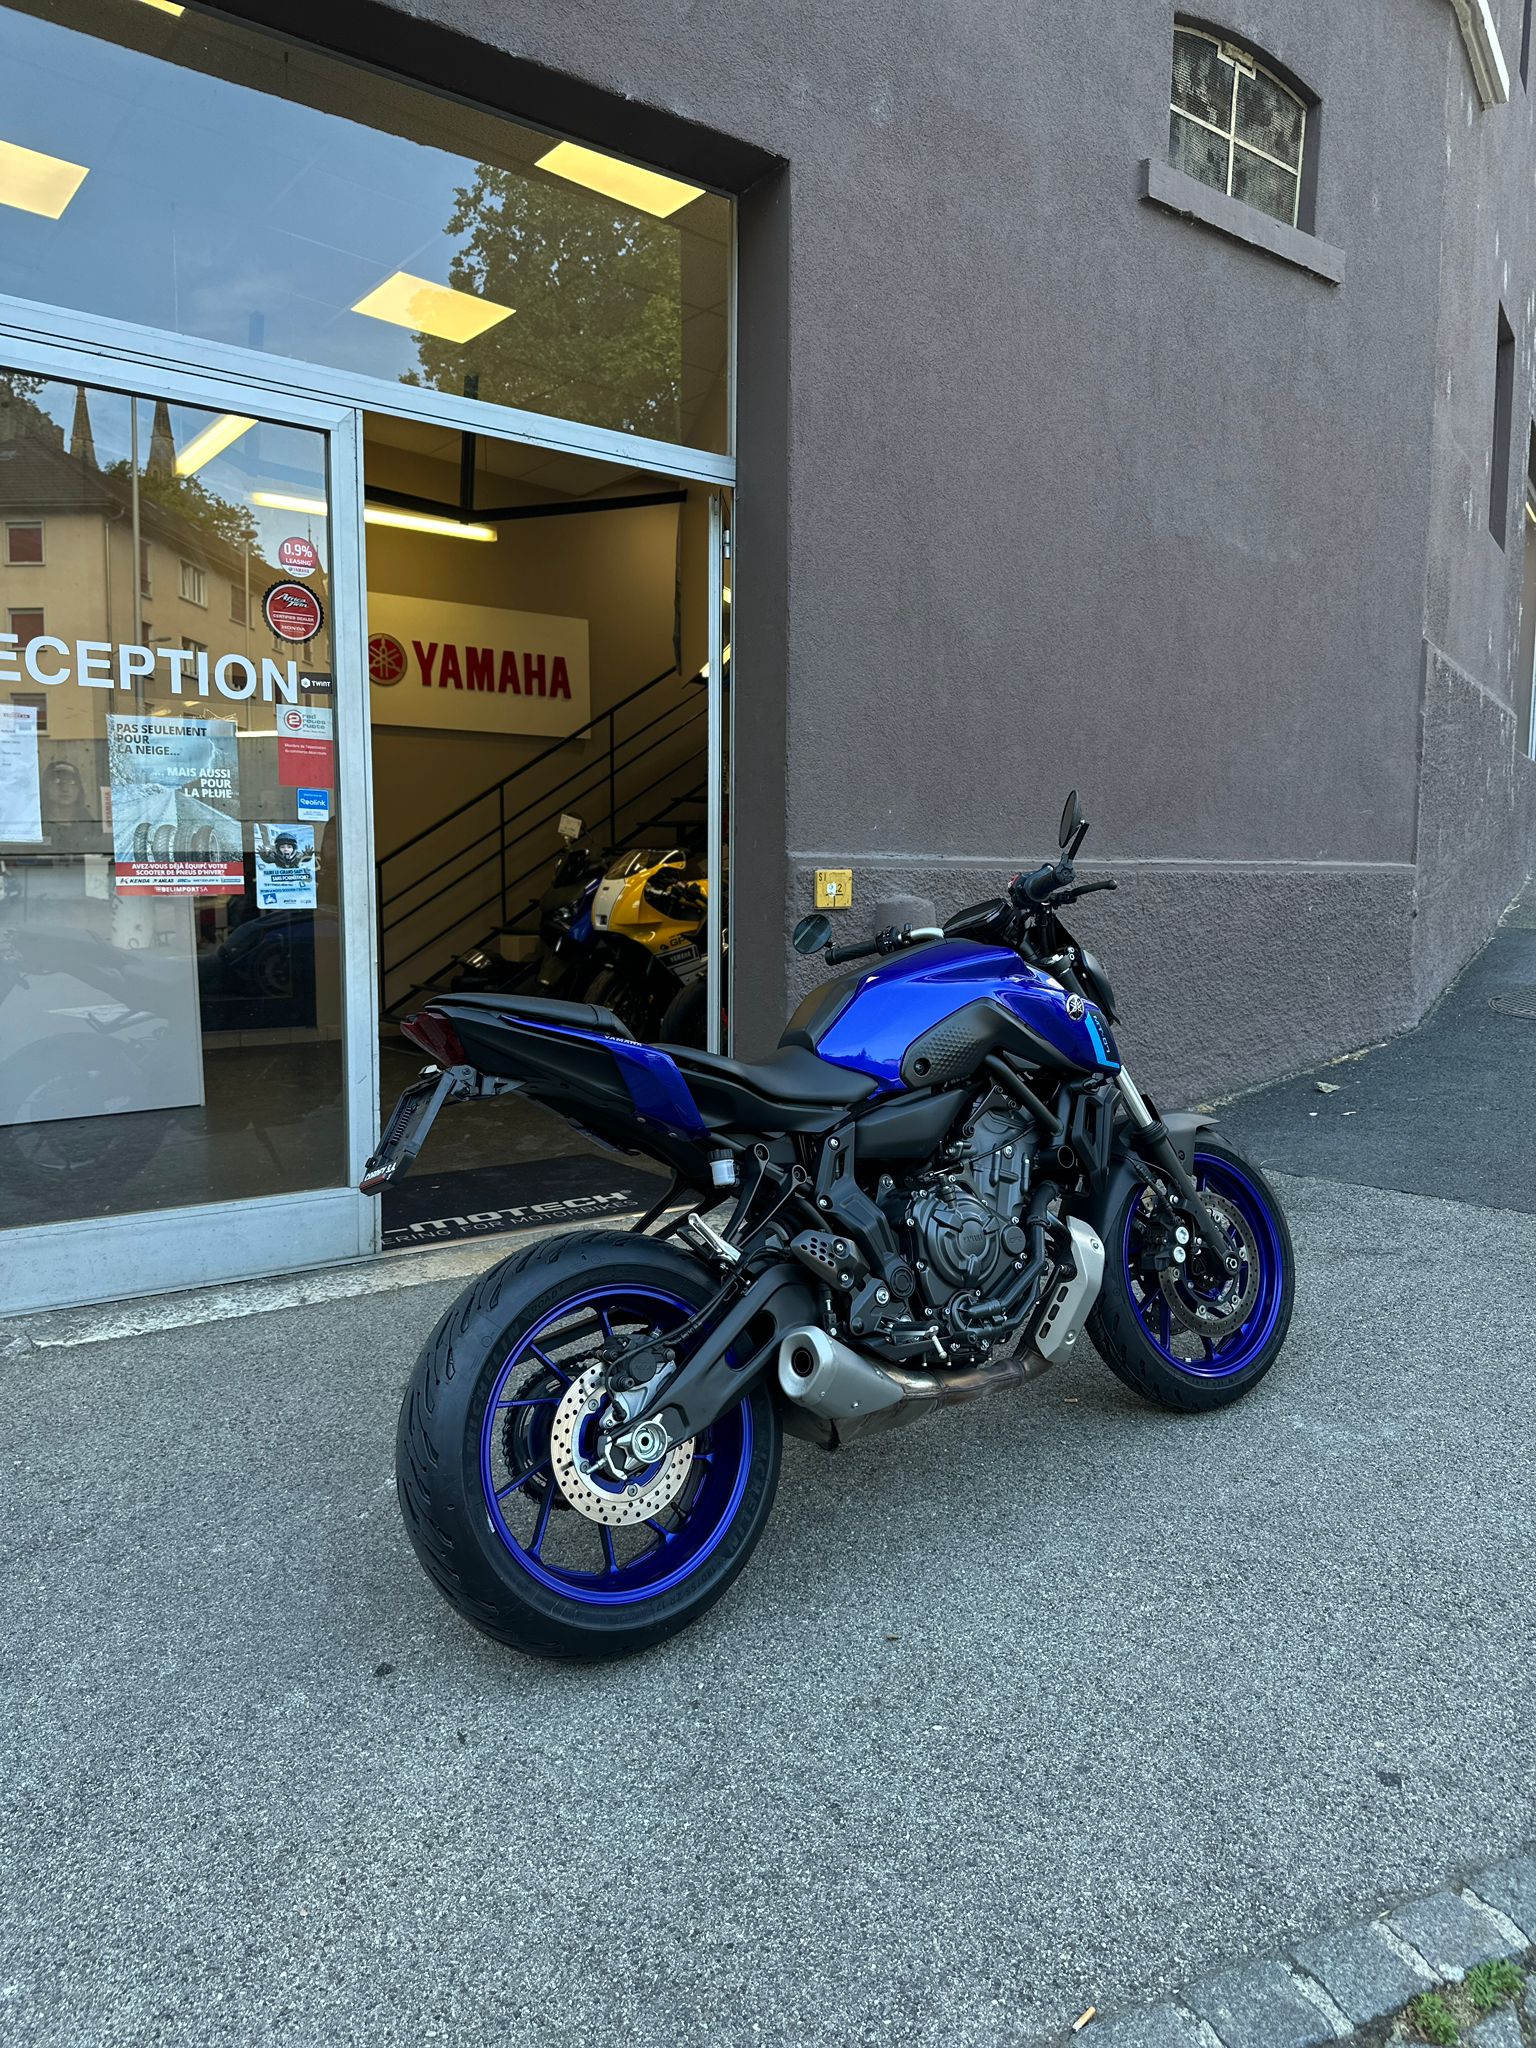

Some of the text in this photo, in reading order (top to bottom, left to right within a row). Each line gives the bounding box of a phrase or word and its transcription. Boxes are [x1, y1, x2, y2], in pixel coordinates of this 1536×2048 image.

[284, 542, 313, 557] 0.9%
[281, 624, 306, 632] HONDA
[412, 640, 572, 699] YAMAHA
[116, 723, 208, 736] PAS SEULEMENT
[117, 734, 150, 744] POUR
[117, 745, 181, 756] LA NEIGE...
[167, 767, 197, 777] MAIS
[199, 768, 231, 779] AUSSI
[200, 779, 232, 789] POUR
[184, 788, 233, 799] LA PLUIE
[169, 862, 184, 870] DÉJÀ
[1092, 1015, 1111, 1053] MT-07
[604, 1035, 642, 1046] YAMAHA
[460, 1221, 502, 1233] FOR
[510, 1200, 639, 1225] MOTORBIKES
